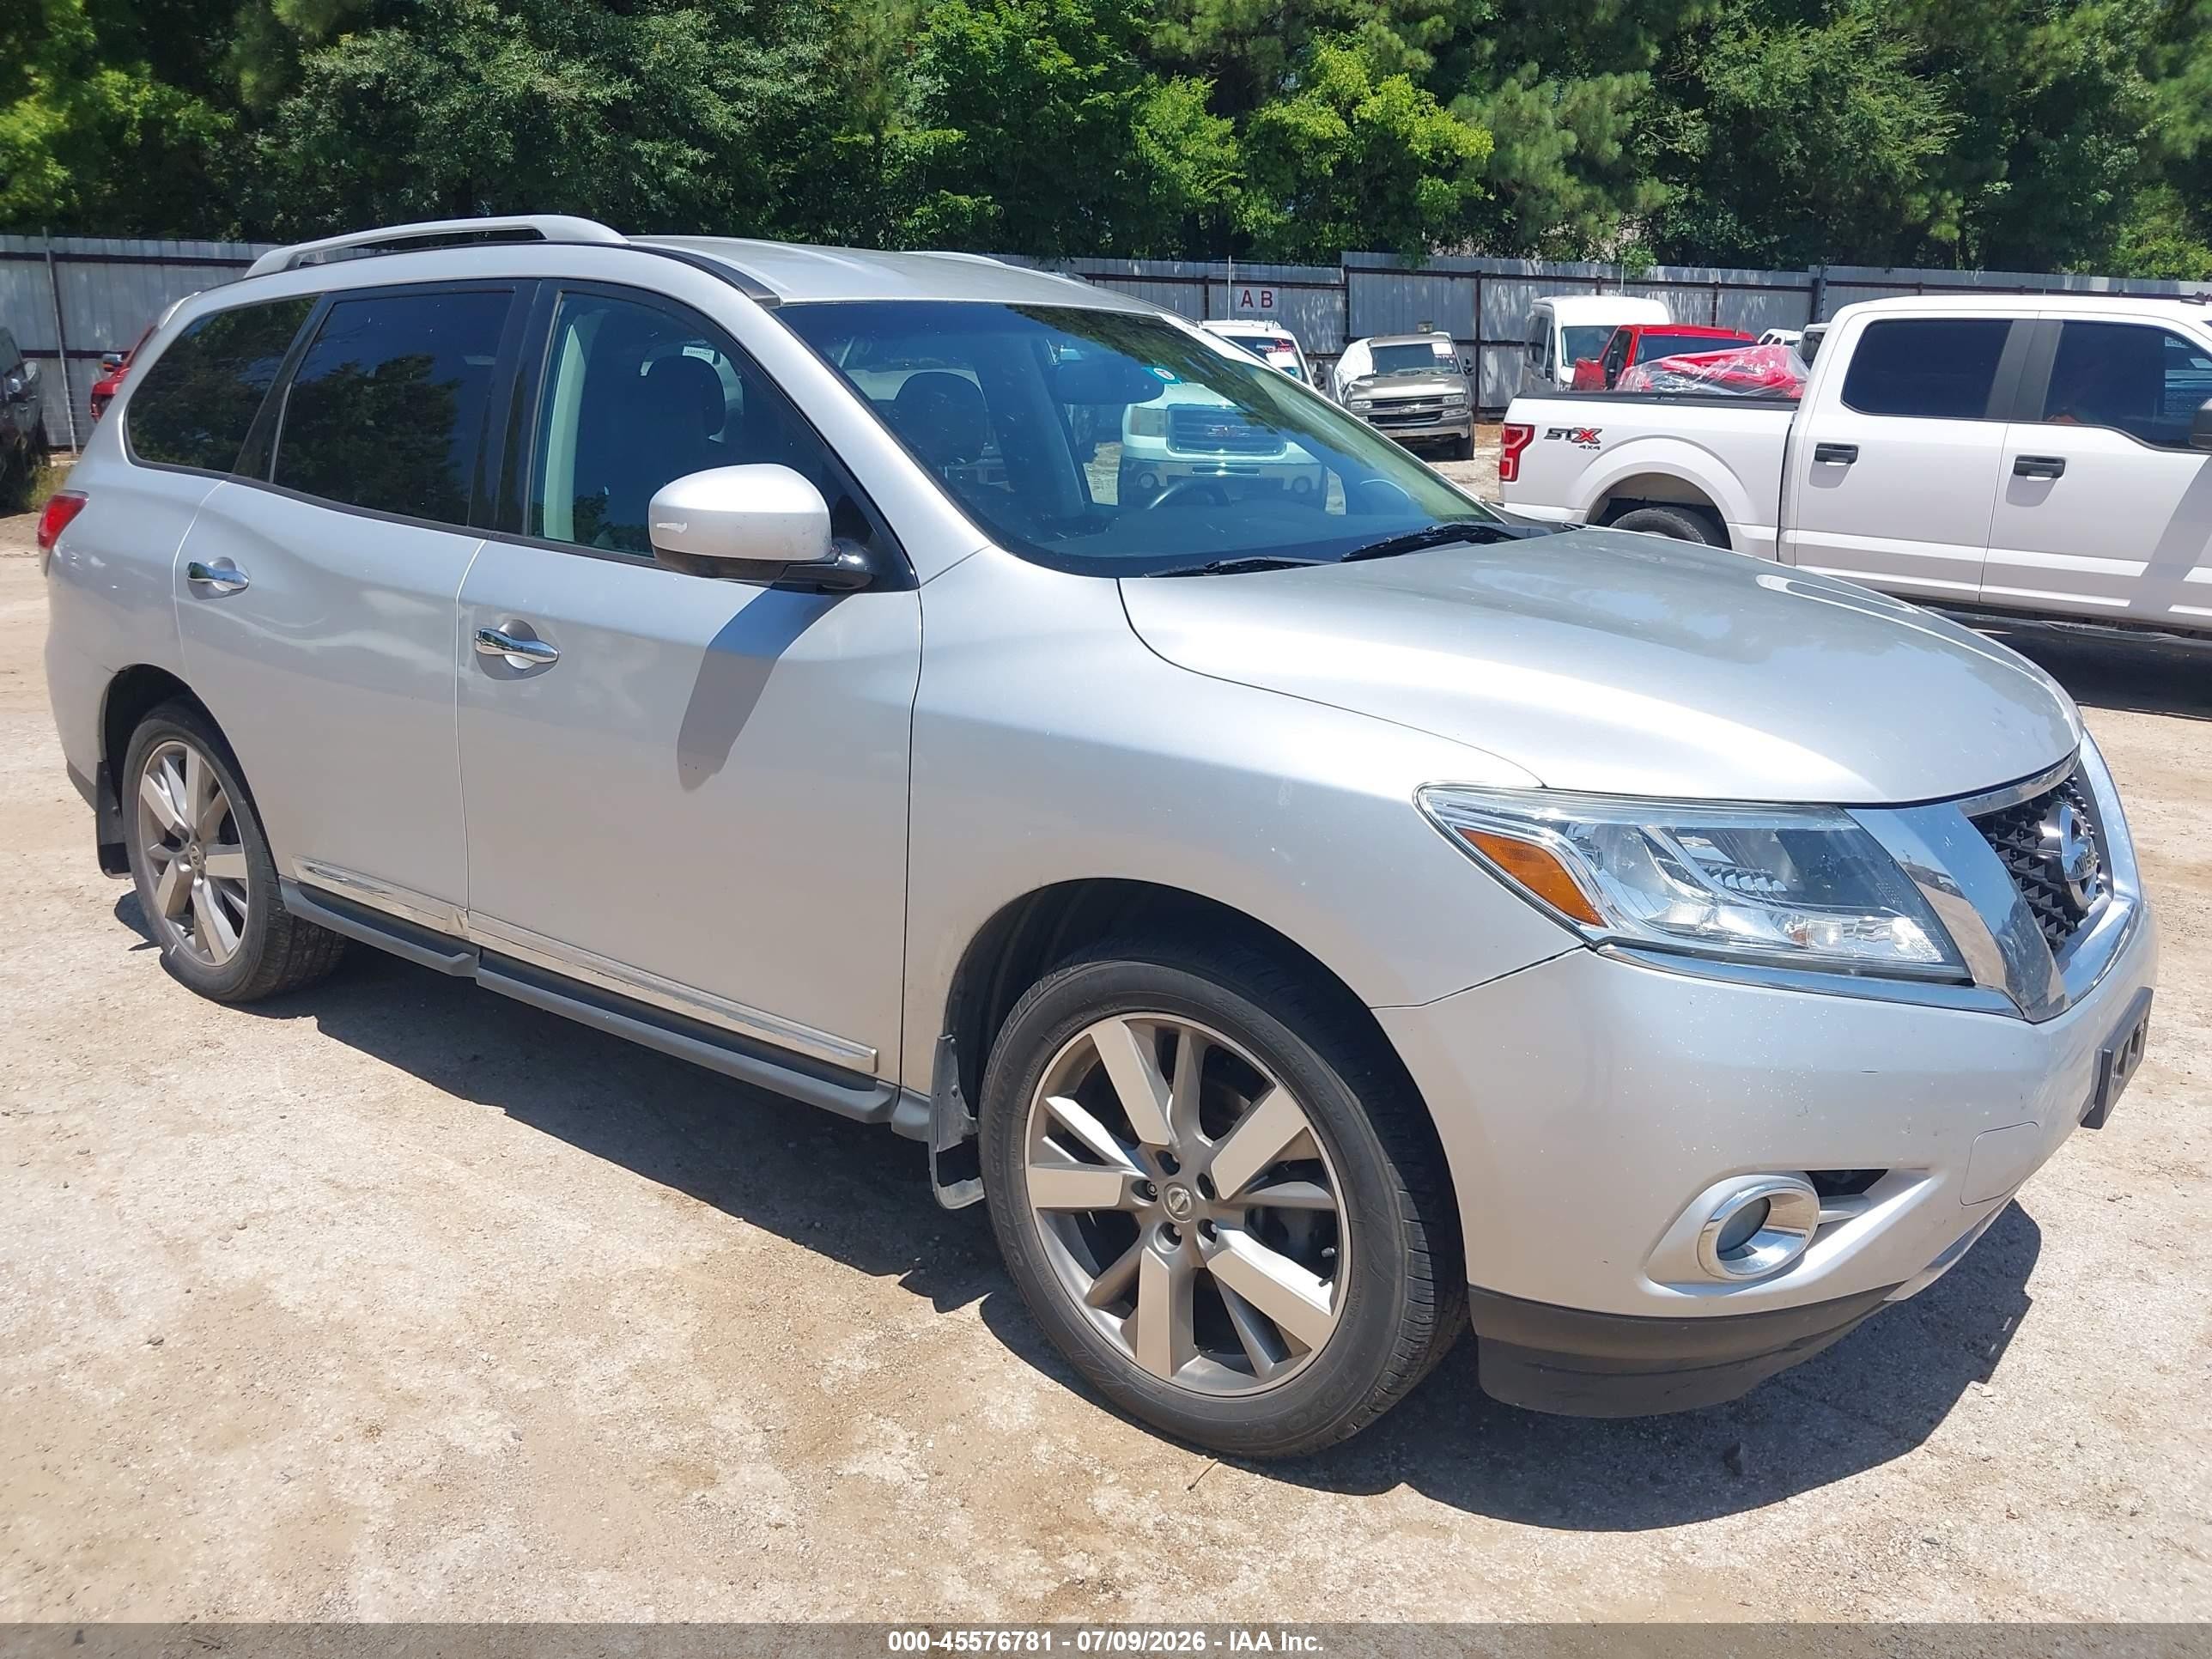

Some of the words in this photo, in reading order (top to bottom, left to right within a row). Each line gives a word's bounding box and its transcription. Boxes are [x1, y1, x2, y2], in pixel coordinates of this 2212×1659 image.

[1241, 289, 1254, 307] A
[1261, 290, 1273, 308] B
[1544, 428, 1602, 444] STX
